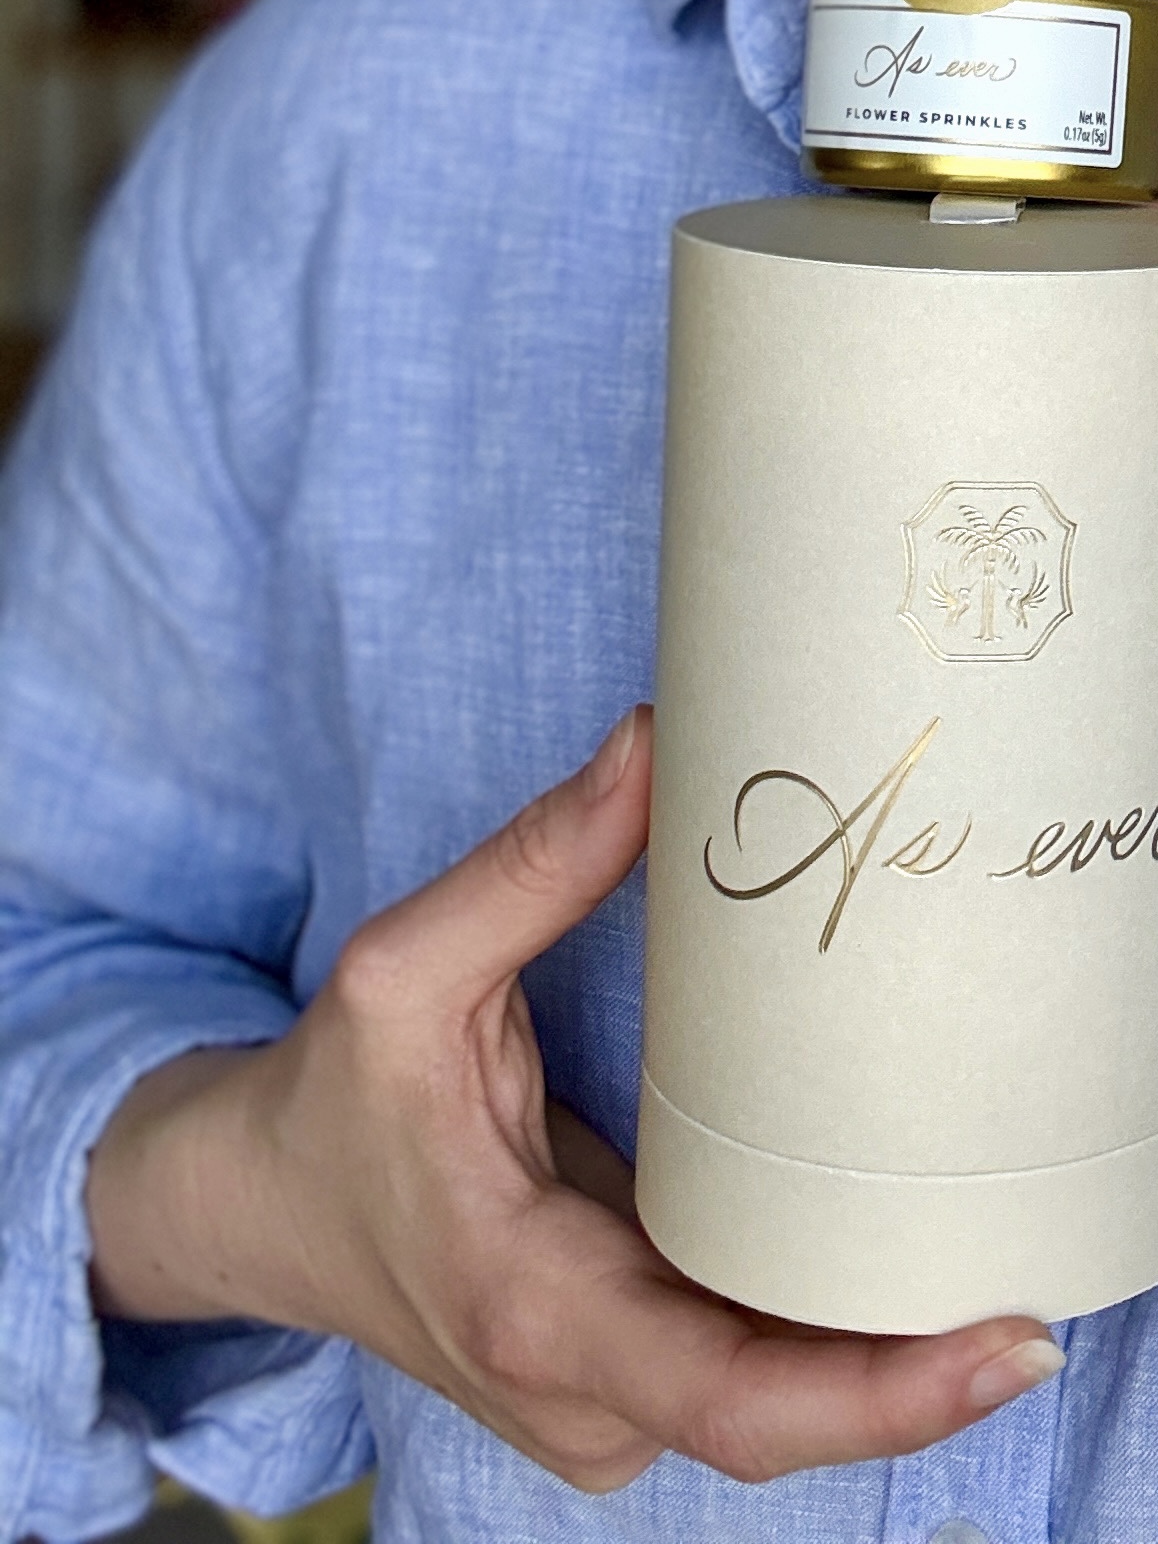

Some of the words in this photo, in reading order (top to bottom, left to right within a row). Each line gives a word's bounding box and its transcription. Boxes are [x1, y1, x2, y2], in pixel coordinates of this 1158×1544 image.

[853, 25, 932, 98] As
[936, 57, 1017, 82] ever
[845, 107, 911, 123] FLOWER
[919, 111, 1028, 131] SPRINKLES
[704, 716, 972, 954] As
